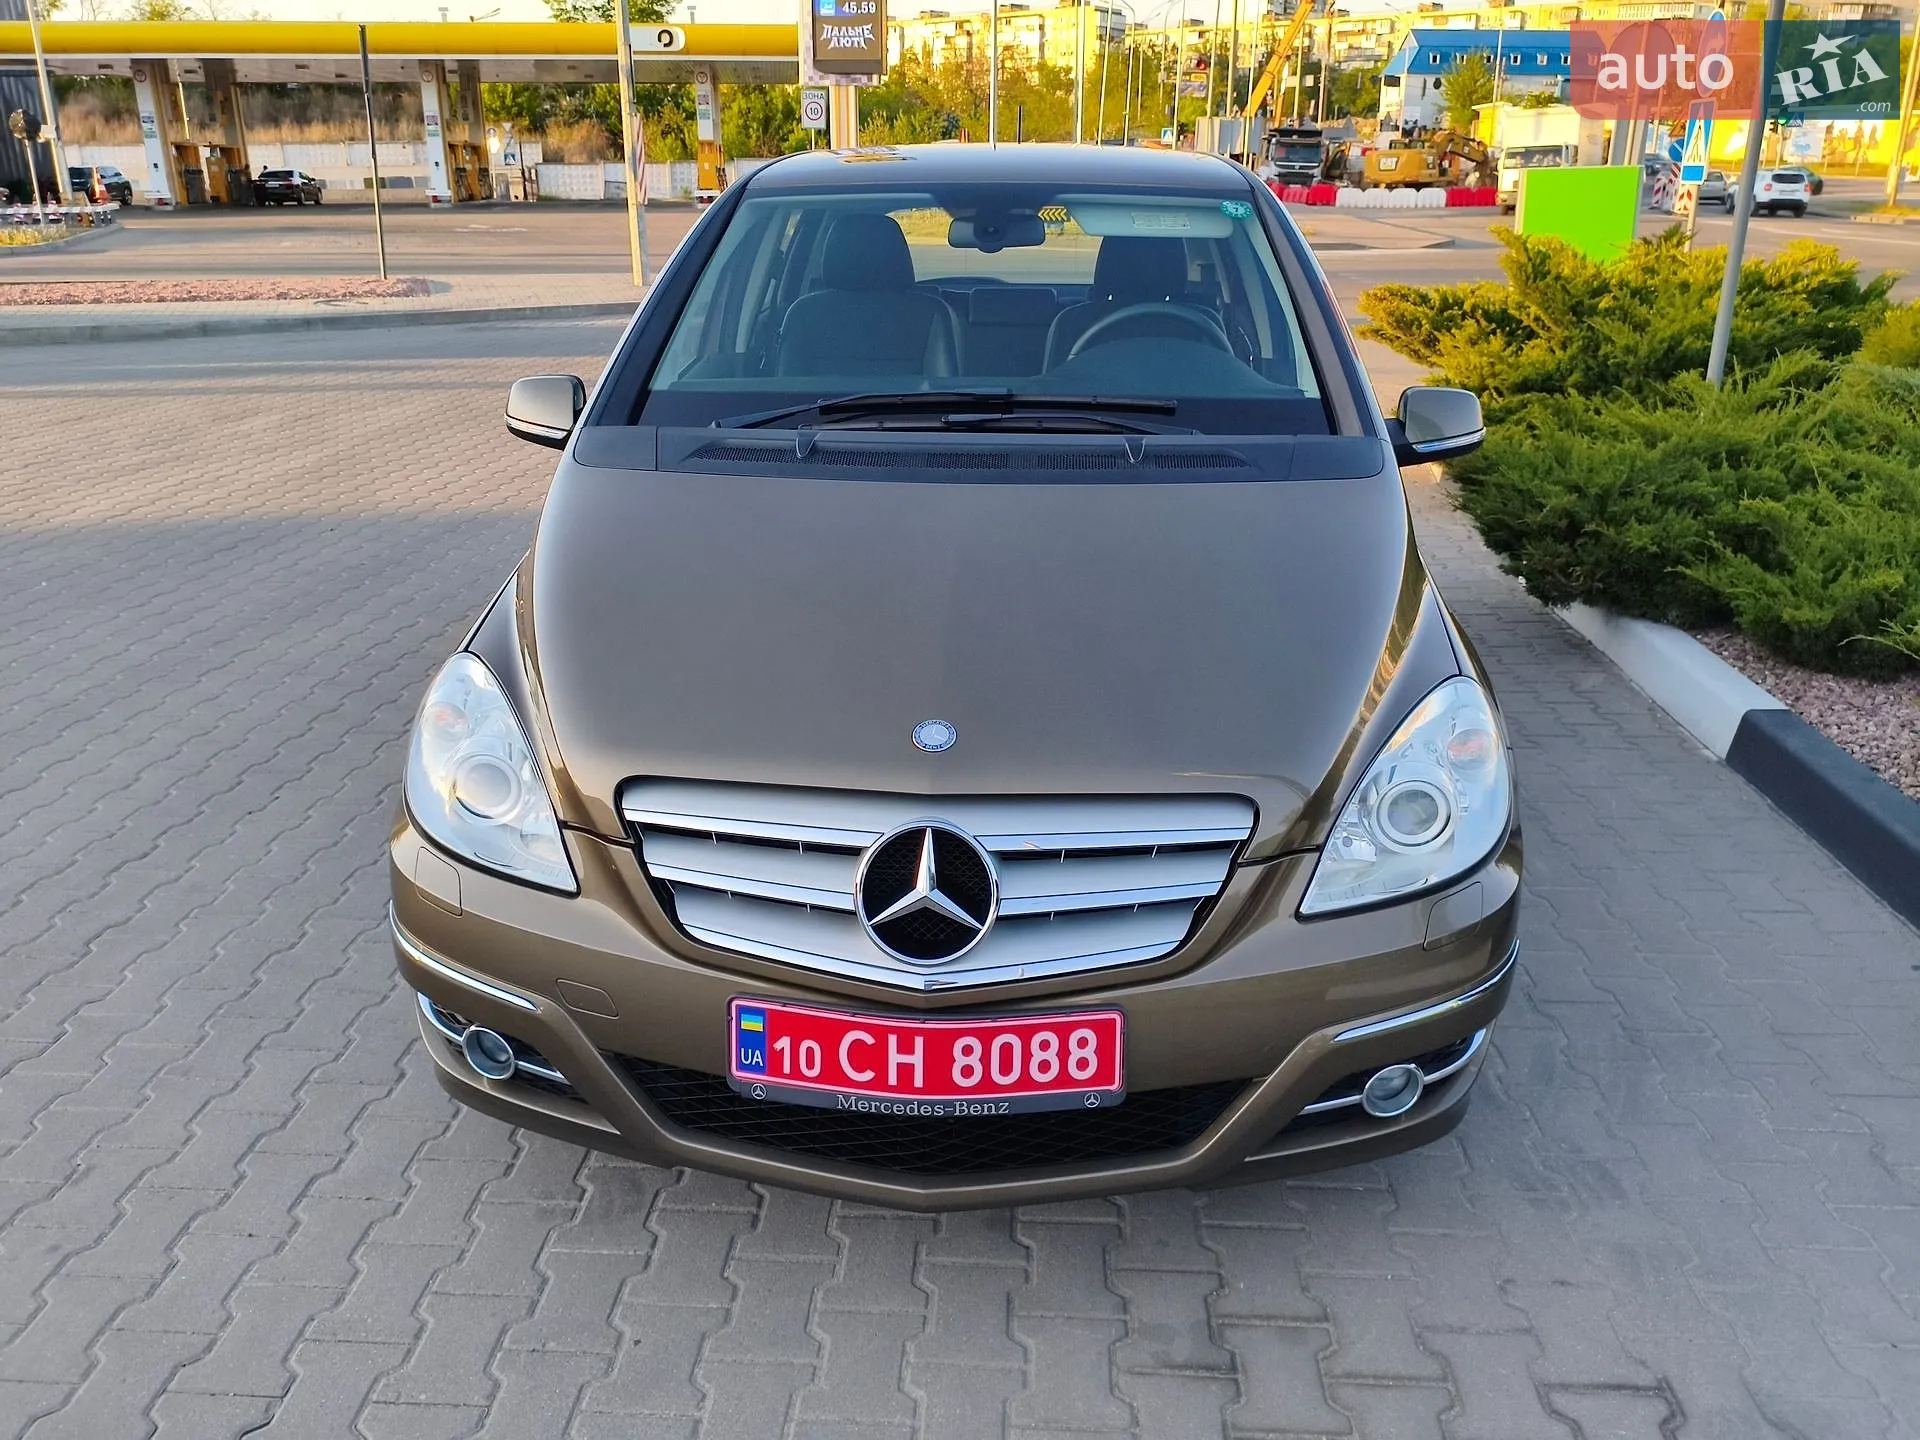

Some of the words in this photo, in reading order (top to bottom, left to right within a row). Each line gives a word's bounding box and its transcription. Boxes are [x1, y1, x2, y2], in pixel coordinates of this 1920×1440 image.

[842, 1, 877, 14] 45.59
[820, 23, 875, 40] ПАЛЬНЕ
[827, 36, 868, 50] ЛЮТІ
[803, 92, 825, 100] ЗОНА
[810, 107, 819, 116] 10
[741, 1049, 764, 1067] UA
[773, 1035, 822, 1078] 10
[838, 1030, 924, 1088] CH
[951, 1028, 1098, 1088] 8088
[836, 1094, 1010, 1117] Mercedes-Benz
